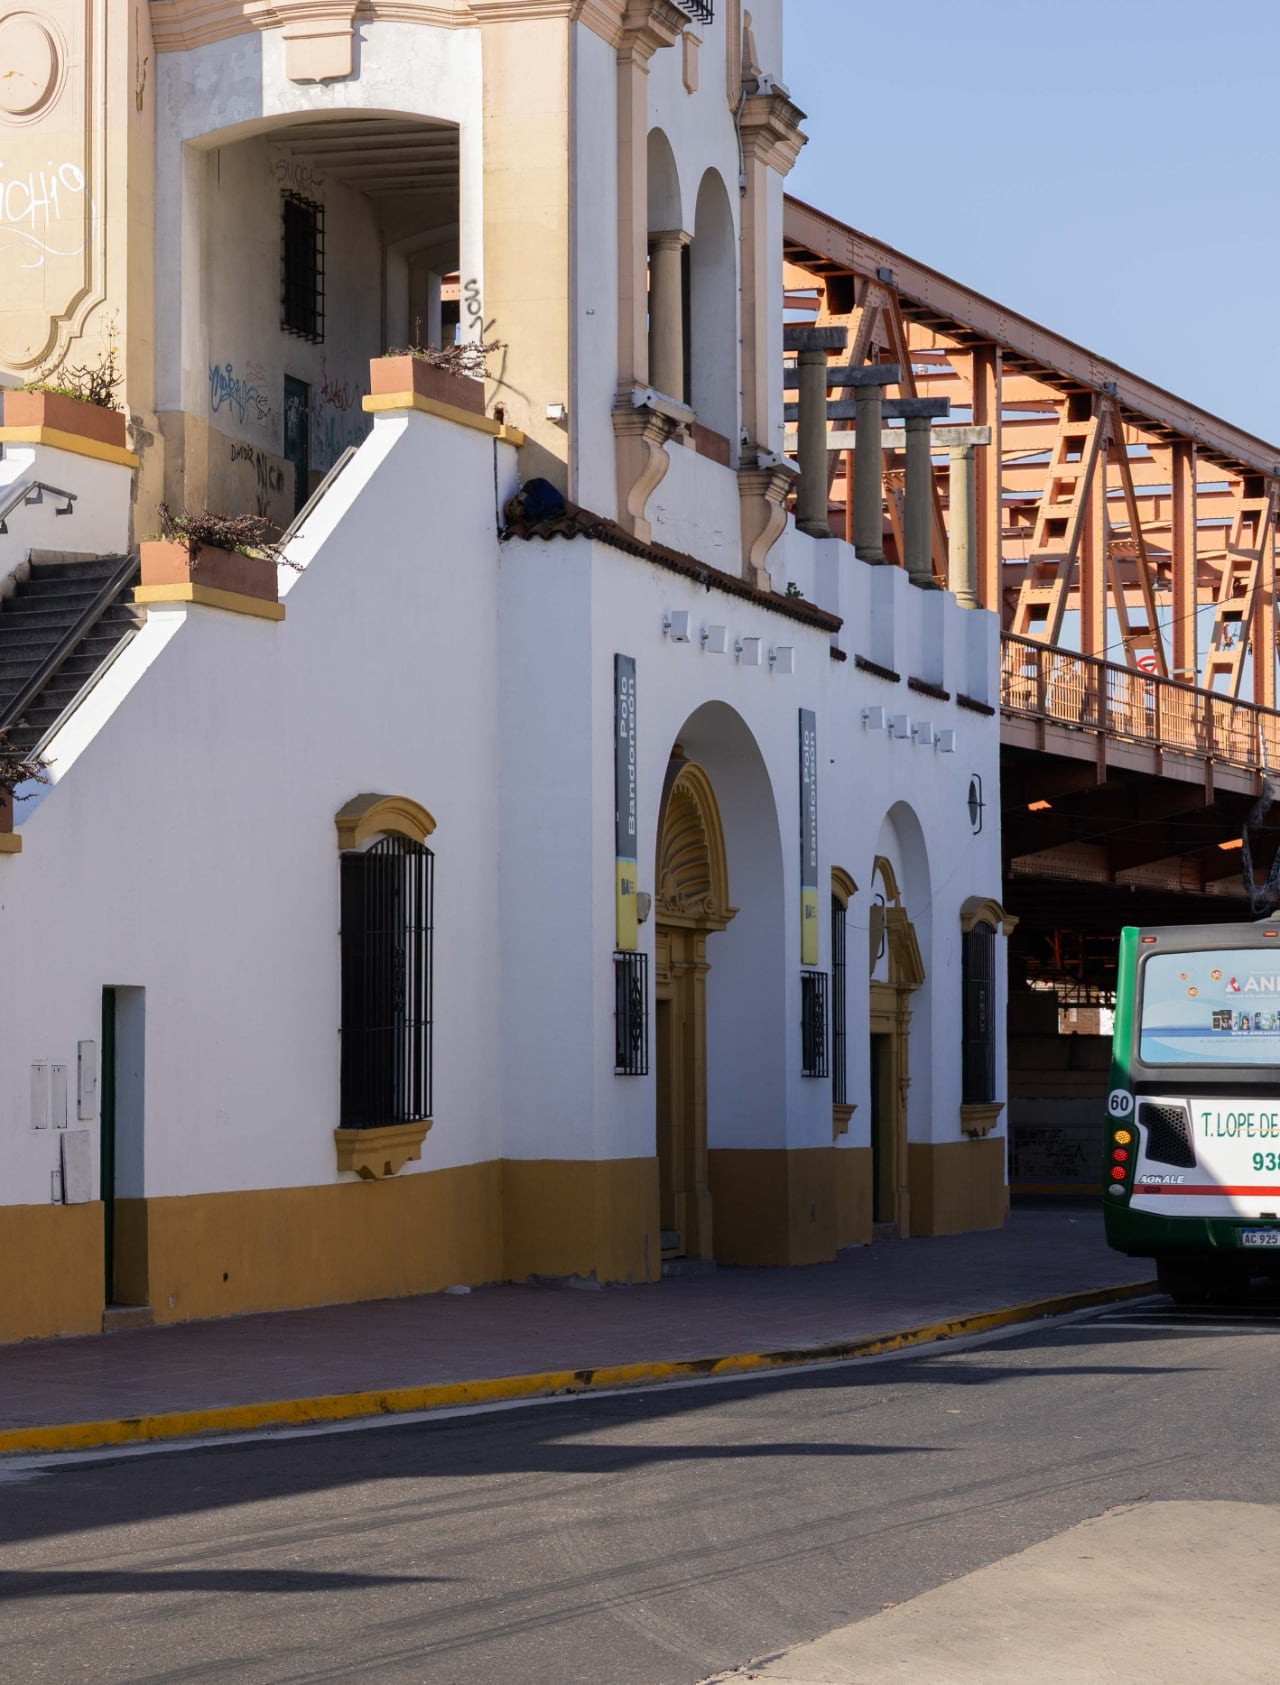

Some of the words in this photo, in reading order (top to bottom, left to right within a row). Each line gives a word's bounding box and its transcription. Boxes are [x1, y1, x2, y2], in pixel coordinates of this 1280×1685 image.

[620, 677, 628, 738] Polo
[627, 678, 636, 835] Bandoneón
[1110, 1095, 1129, 1112] 60
[1260, 1113, 1279, 1138] DE
[1252, 1152, 1280, 1171] 93
[1245, 1235, 1256, 1245] AC
[1260, 1235, 1278, 1245] 925
